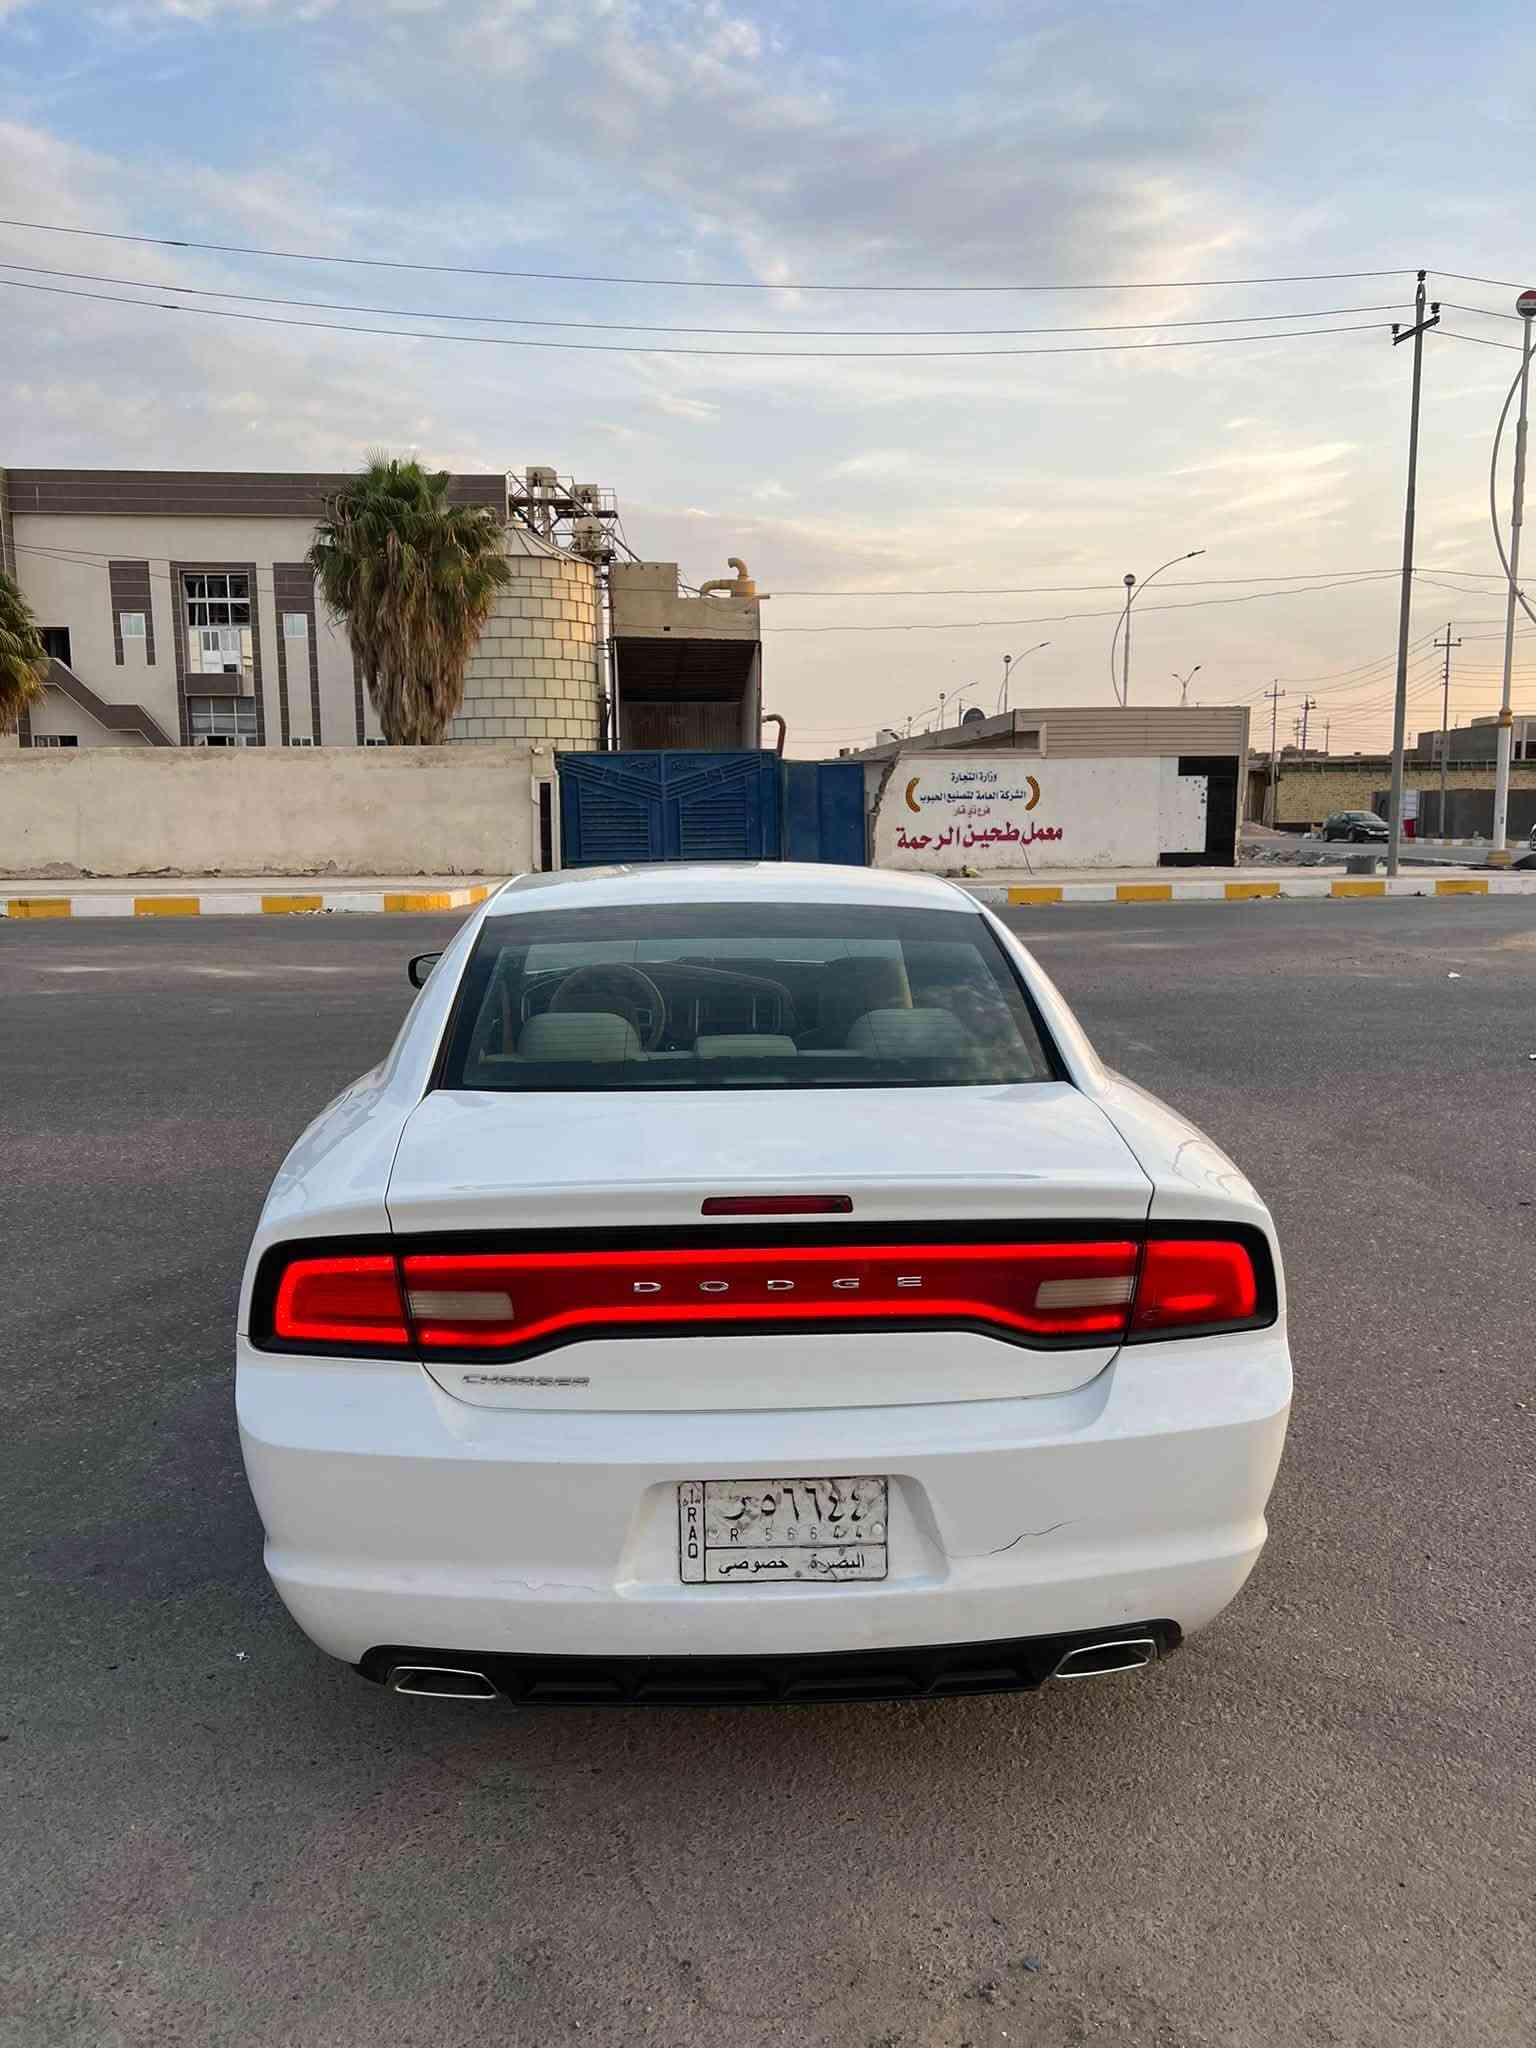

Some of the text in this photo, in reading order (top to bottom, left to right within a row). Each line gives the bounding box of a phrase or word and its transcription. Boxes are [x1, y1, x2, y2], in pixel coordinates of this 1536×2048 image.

[951, 770, 998, 784] وزارة التجارة
[947, 790, 974, 804] لتصنيع
[975, 791, 999, 801] العامة
[1000, 790, 1027, 802] الشركة
[896, 822, 1063, 851] معمل طحين الرحمة
[633, 1275, 923, 1293] DODGE
[462, 1374, 590, 1388] CHARGER
[718, 1552, 865, 1577] البصرة خصوصي
